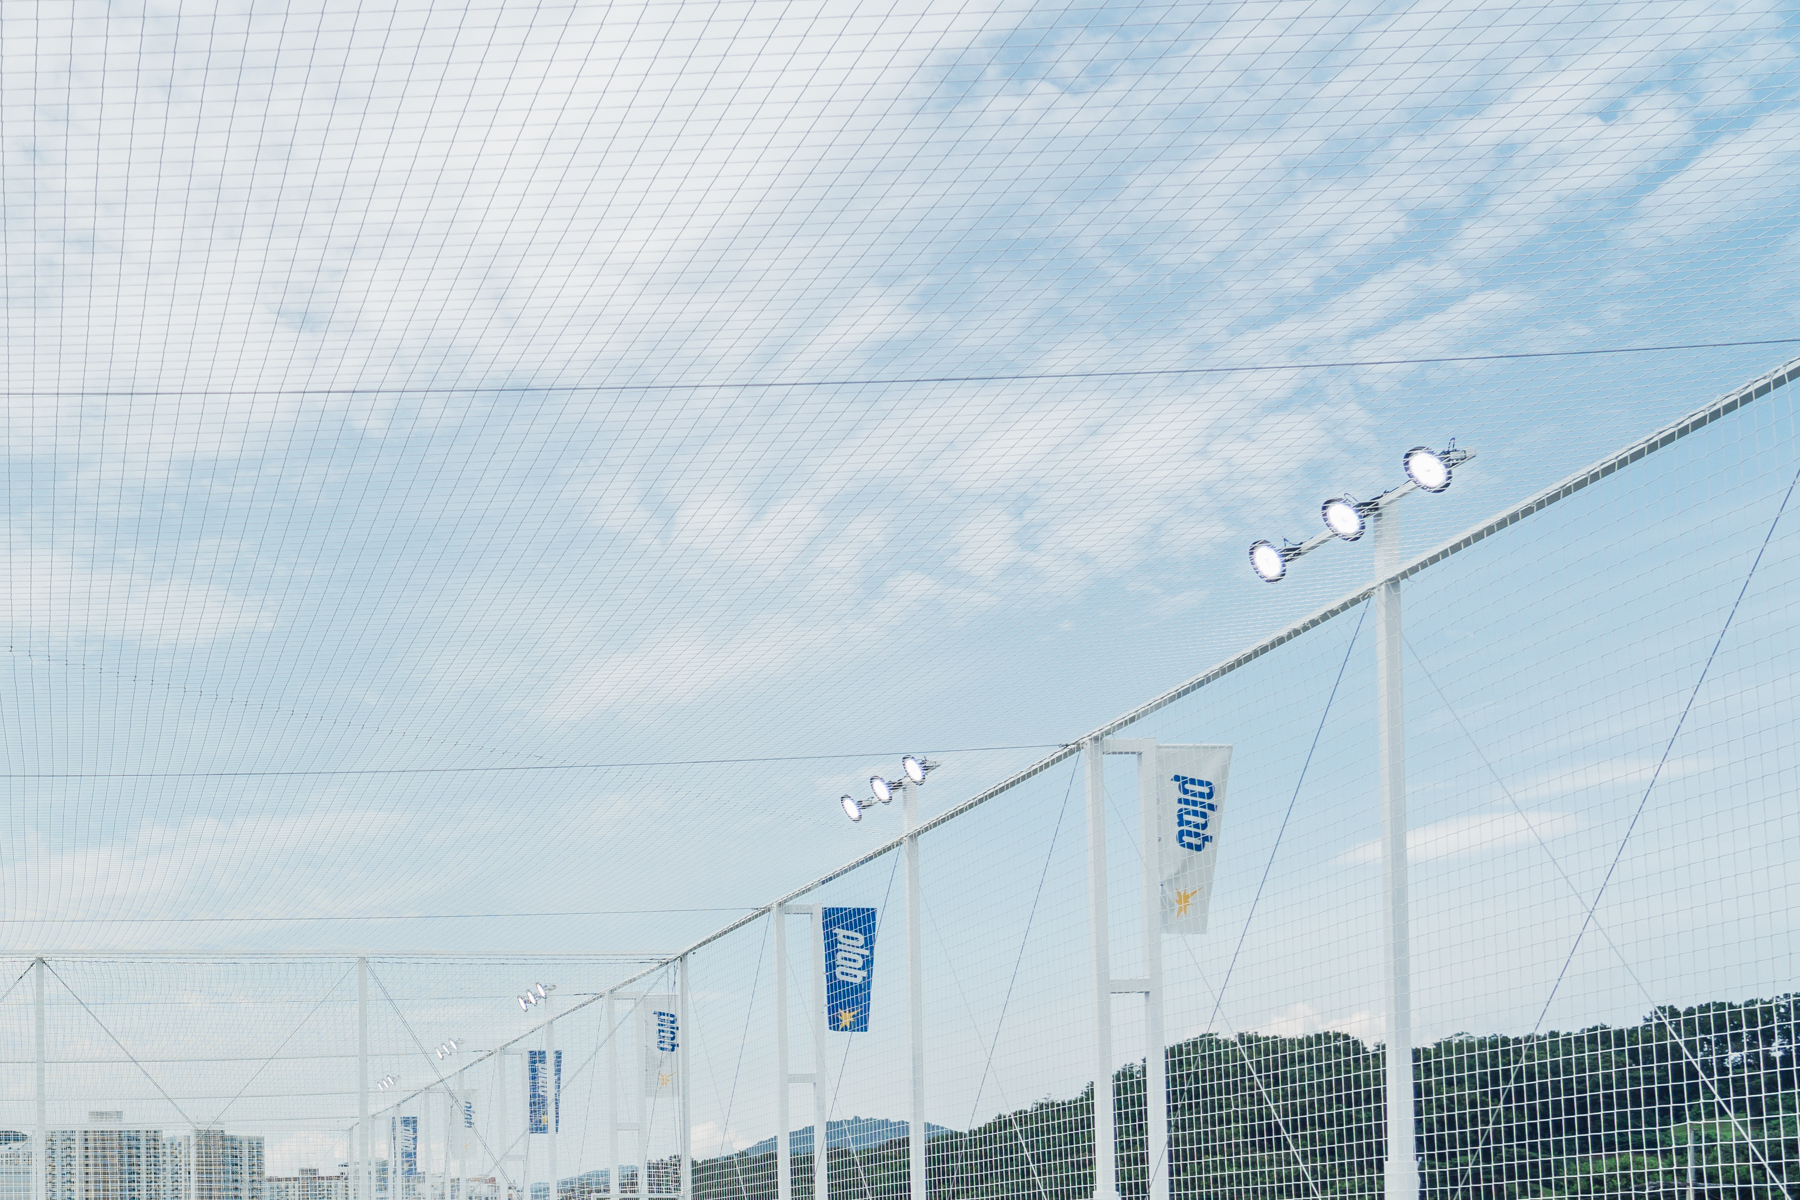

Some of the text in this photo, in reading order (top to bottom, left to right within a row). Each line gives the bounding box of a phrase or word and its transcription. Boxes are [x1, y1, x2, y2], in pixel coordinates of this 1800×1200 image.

[1170, 774, 1218, 852] plab
[833, 928, 870, 985] plab
[653, 1011, 680, 1053] plab
